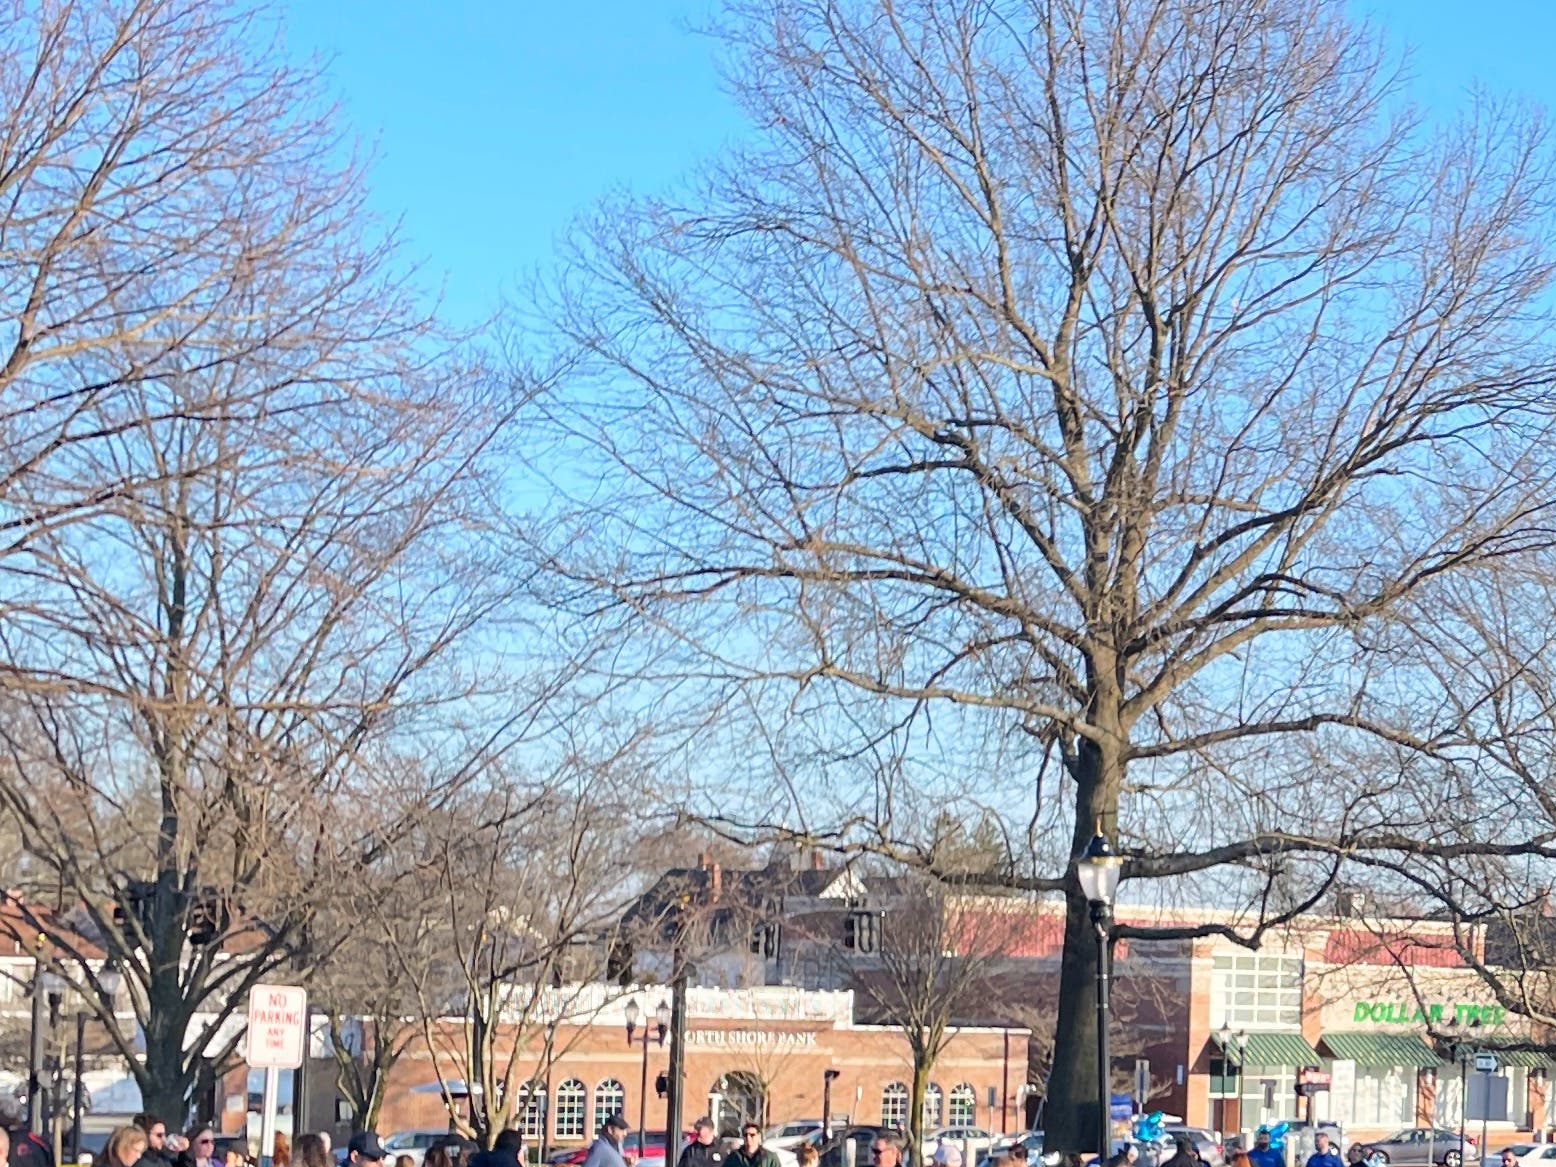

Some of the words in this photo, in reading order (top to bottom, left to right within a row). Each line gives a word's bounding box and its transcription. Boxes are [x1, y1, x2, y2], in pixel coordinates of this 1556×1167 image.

[269, 993, 287, 1008] NO
[253, 1010, 299, 1025] PARKING
[1353, 1002, 1443, 1023] DOLLAR
[1454, 1004, 1506, 1025] TREE
[268, 1027, 285, 1036] ANY
[684, 1030, 726, 1046] ORTH
[728, 1031, 776, 1046] SHORE
[778, 1032, 817, 1046] BANK
